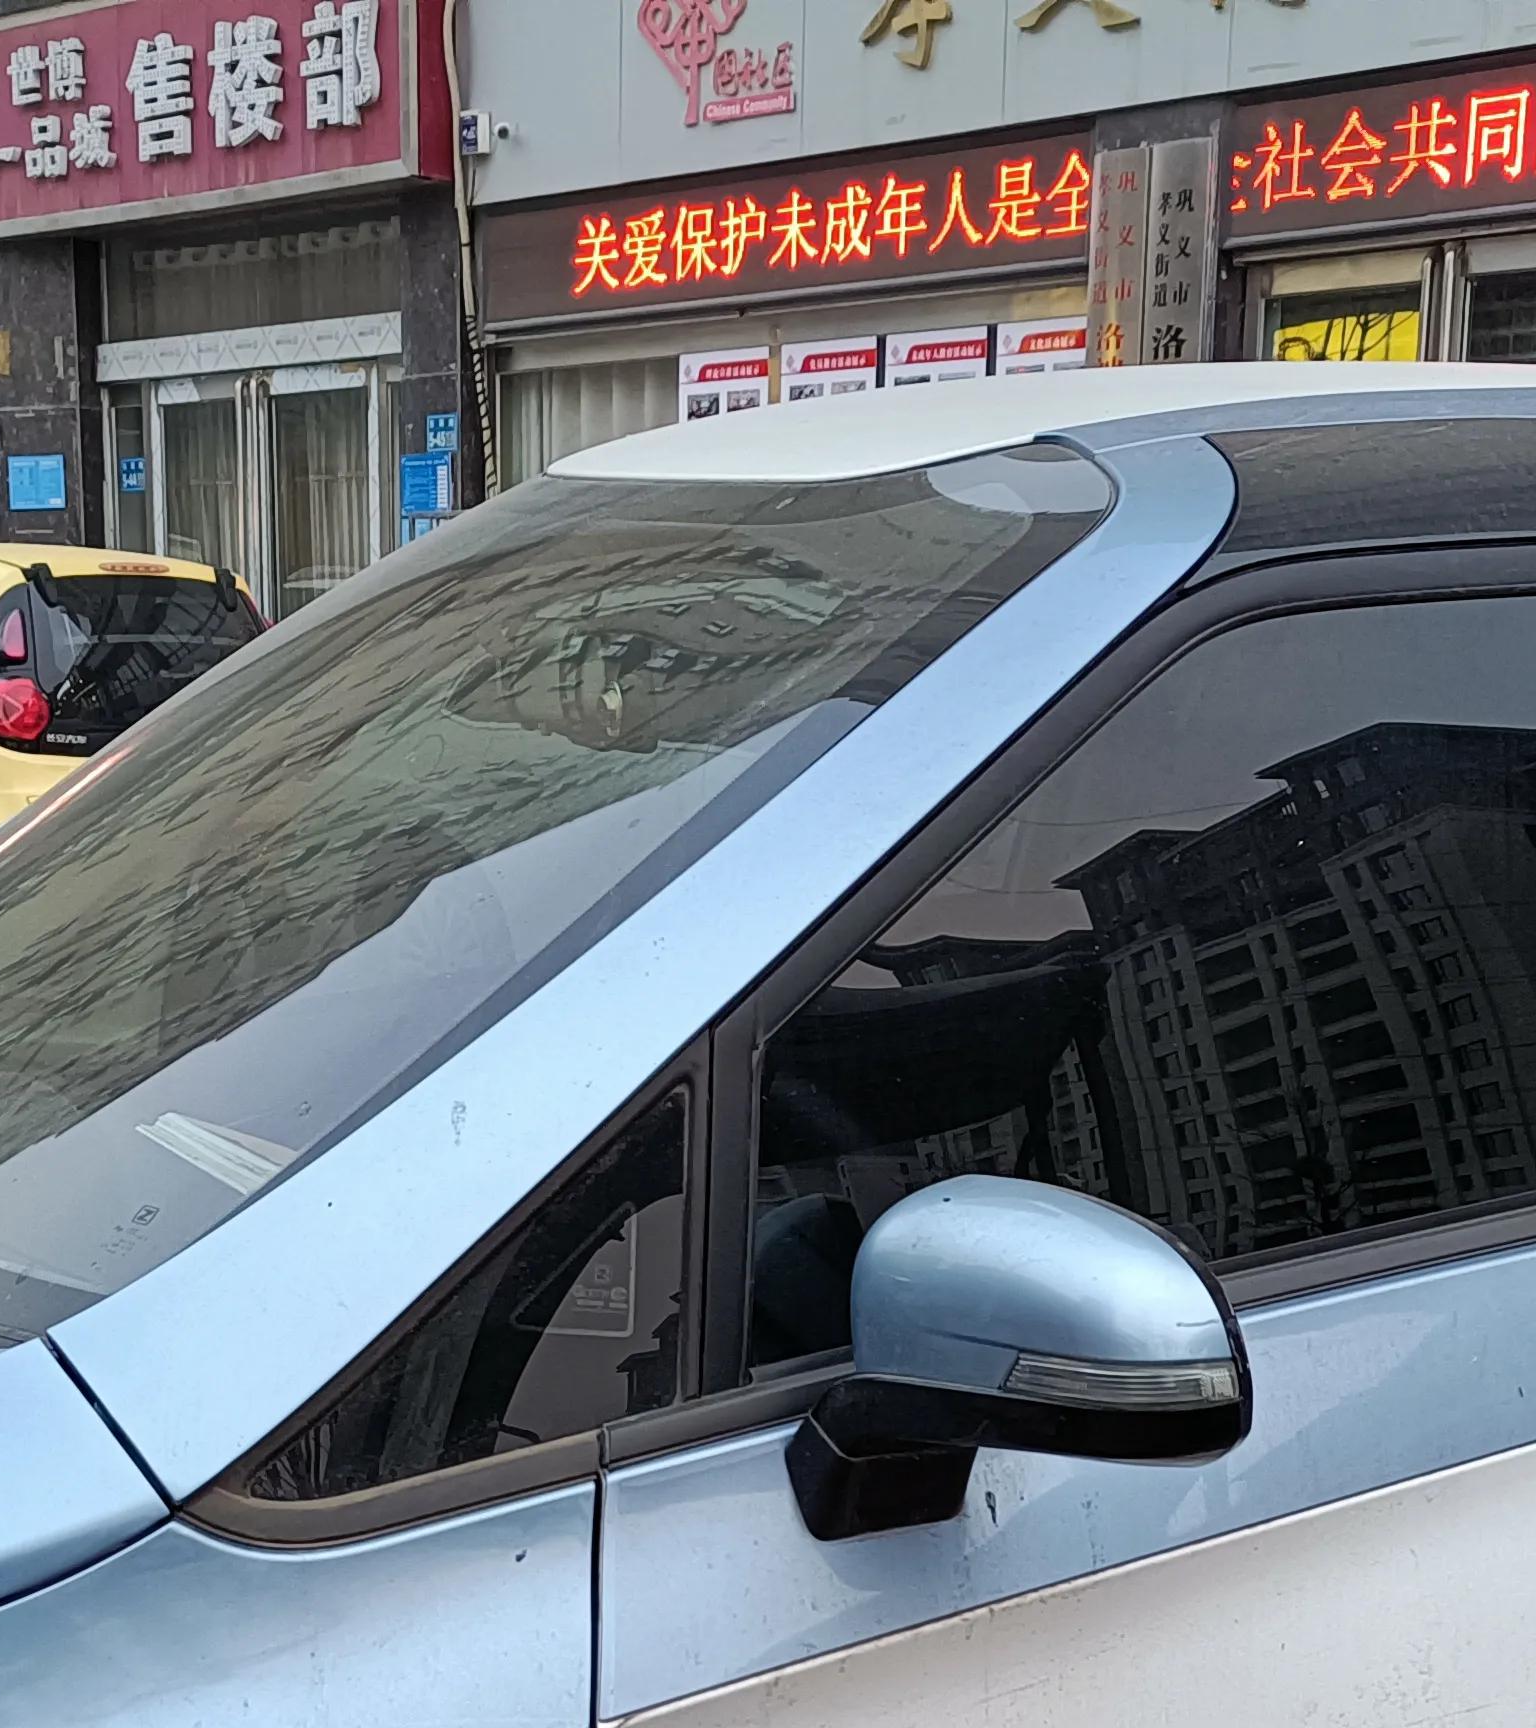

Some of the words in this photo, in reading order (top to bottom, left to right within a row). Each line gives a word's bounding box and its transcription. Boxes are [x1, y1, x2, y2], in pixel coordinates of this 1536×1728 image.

[7, 37, 87, 107] 世博
[125, 0, 381, 163] 售楼部
[571, 149, 1091, 298] 关爱保护未成年人是全
[1151, 324, 1188, 361] 洛
